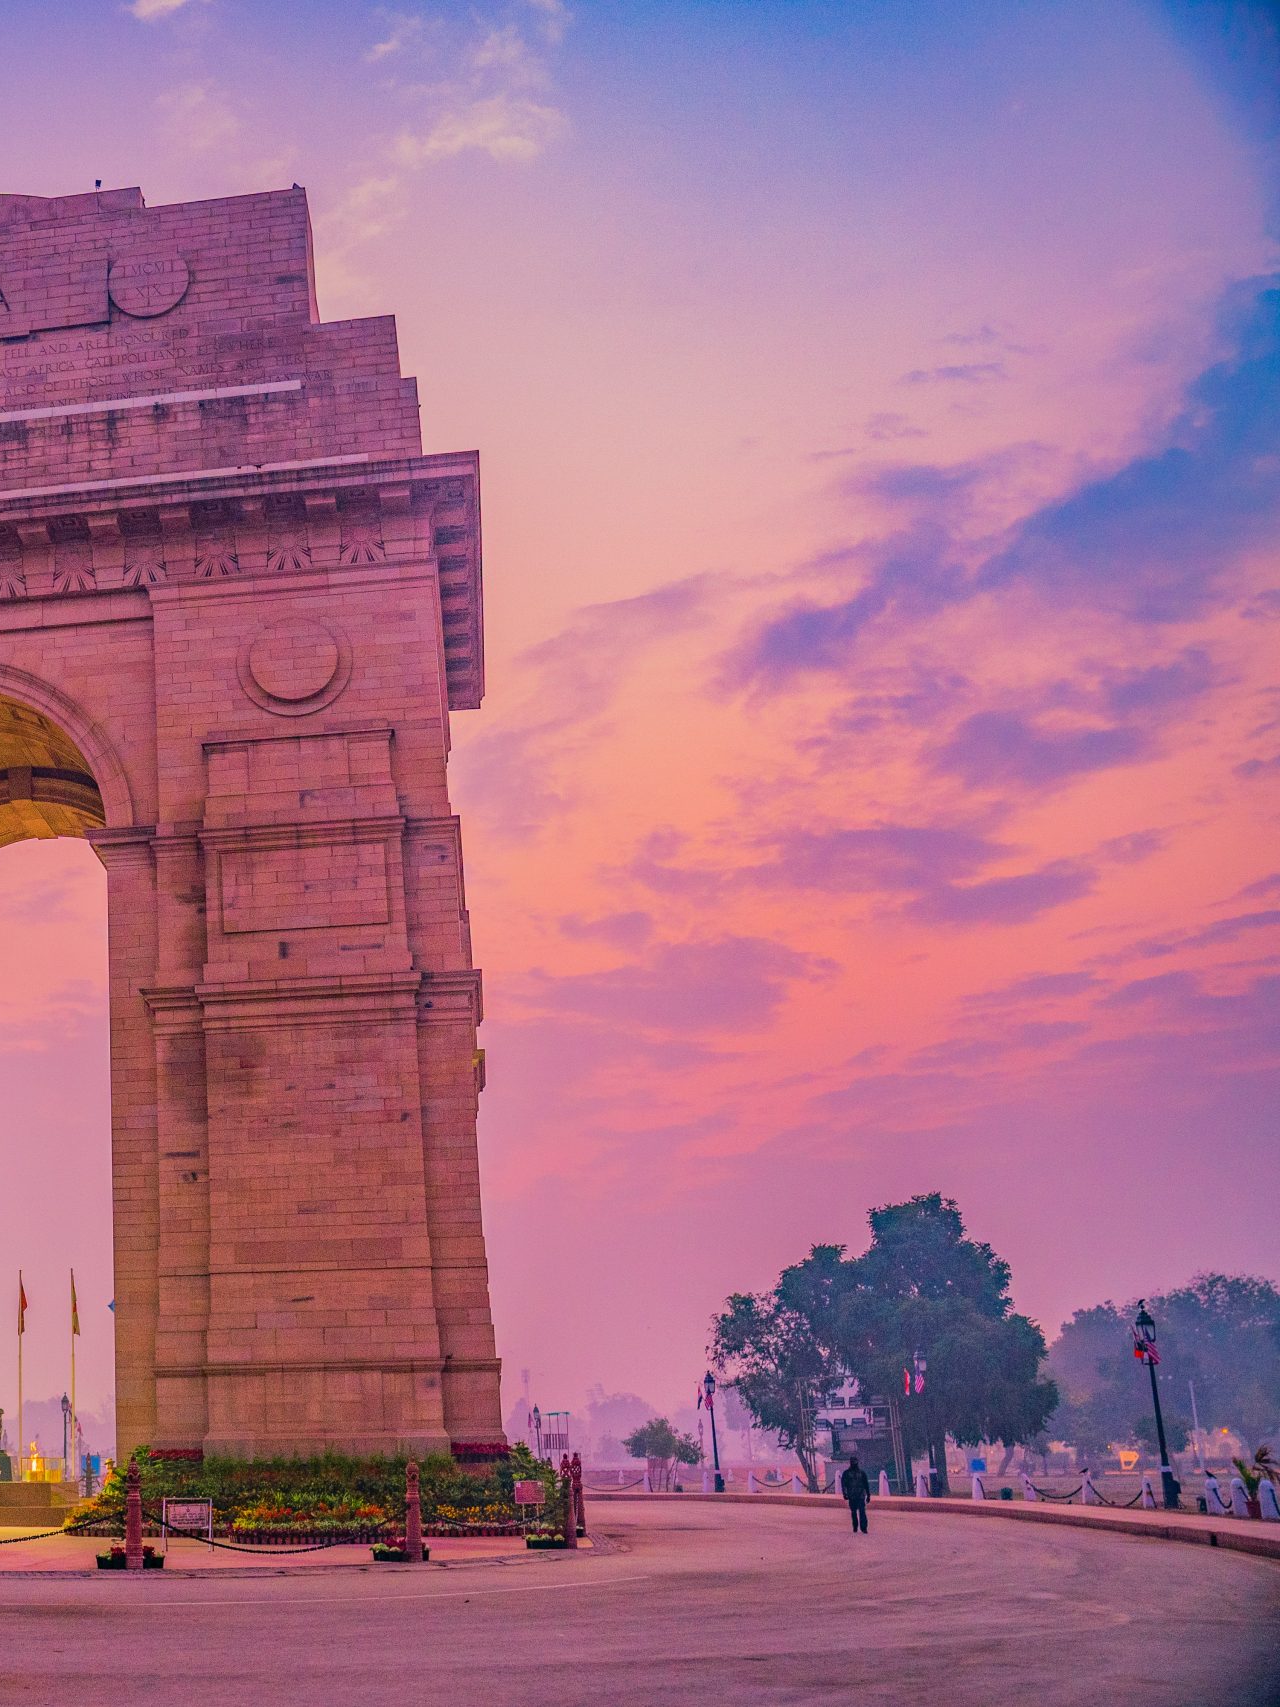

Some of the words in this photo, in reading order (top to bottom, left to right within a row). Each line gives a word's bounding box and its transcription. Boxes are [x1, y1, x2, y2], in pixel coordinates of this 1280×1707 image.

[132, 261, 164, 275] MCM
[136, 284, 163, 298] XIX
[5, 347, 29, 359] FELL
[40, 343, 68, 355] AND
[76, 338, 102, 350] ARE
[116, 328, 189, 346] HONOURED
[28, 361, 75, 376] AFRICA
[158, 348, 186, 359] AND
[5, 384, 36, 397] ALSO
[44, 381, 58, 392] OF
[72, 376, 112, 390] THOSE
[122, 368, 166, 383] WHOSE
[179, 362, 224, 376] NAMES
